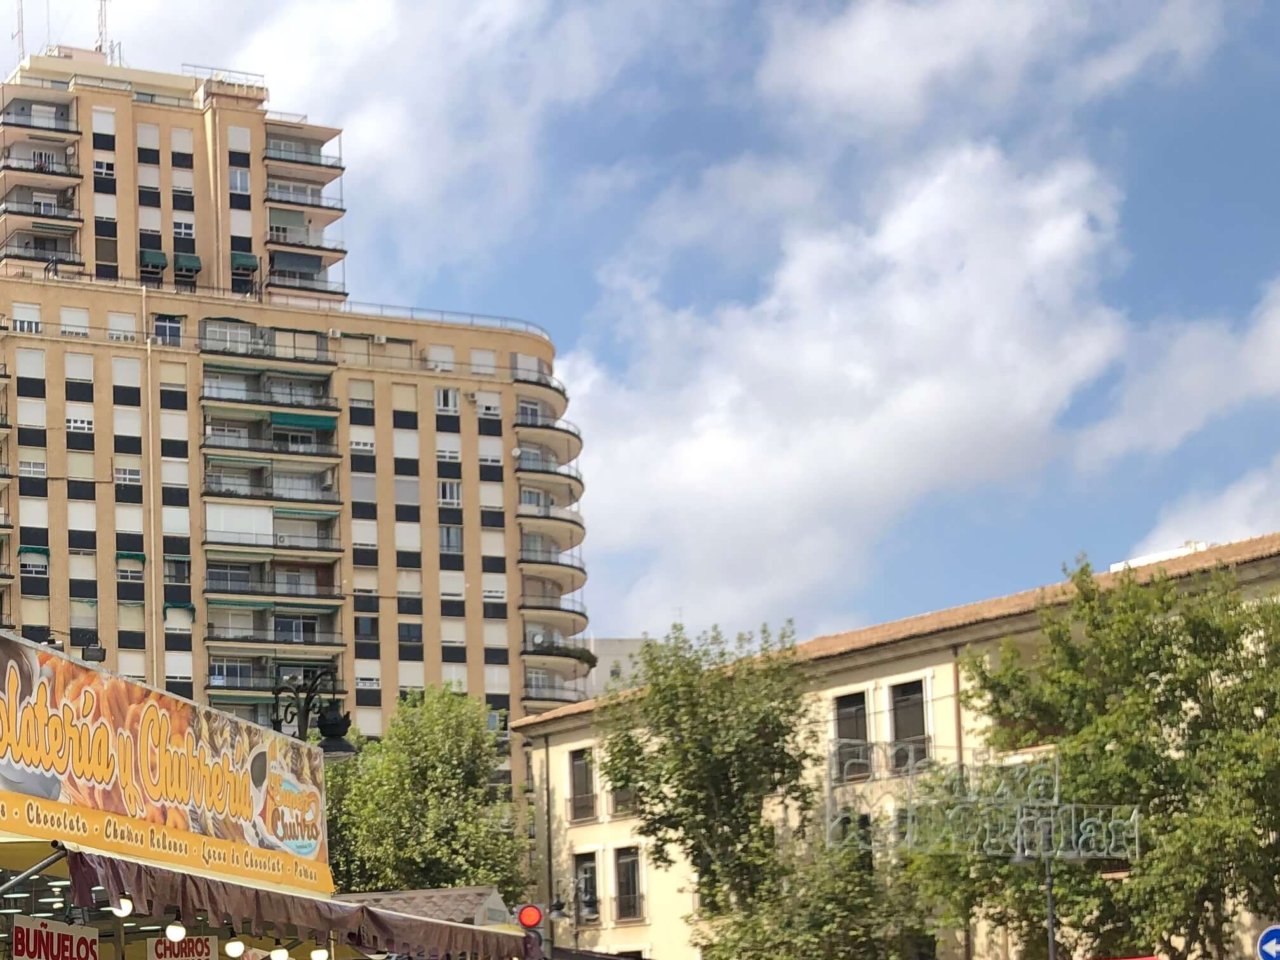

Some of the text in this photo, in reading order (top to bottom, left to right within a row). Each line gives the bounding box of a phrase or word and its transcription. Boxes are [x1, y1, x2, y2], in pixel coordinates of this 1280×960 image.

[119, 733, 144, 818] y
[26, 803, 88, 832] Chocolate
[271, 807, 320, 842] Churro
[154, 937, 211, 959] CHURROS
